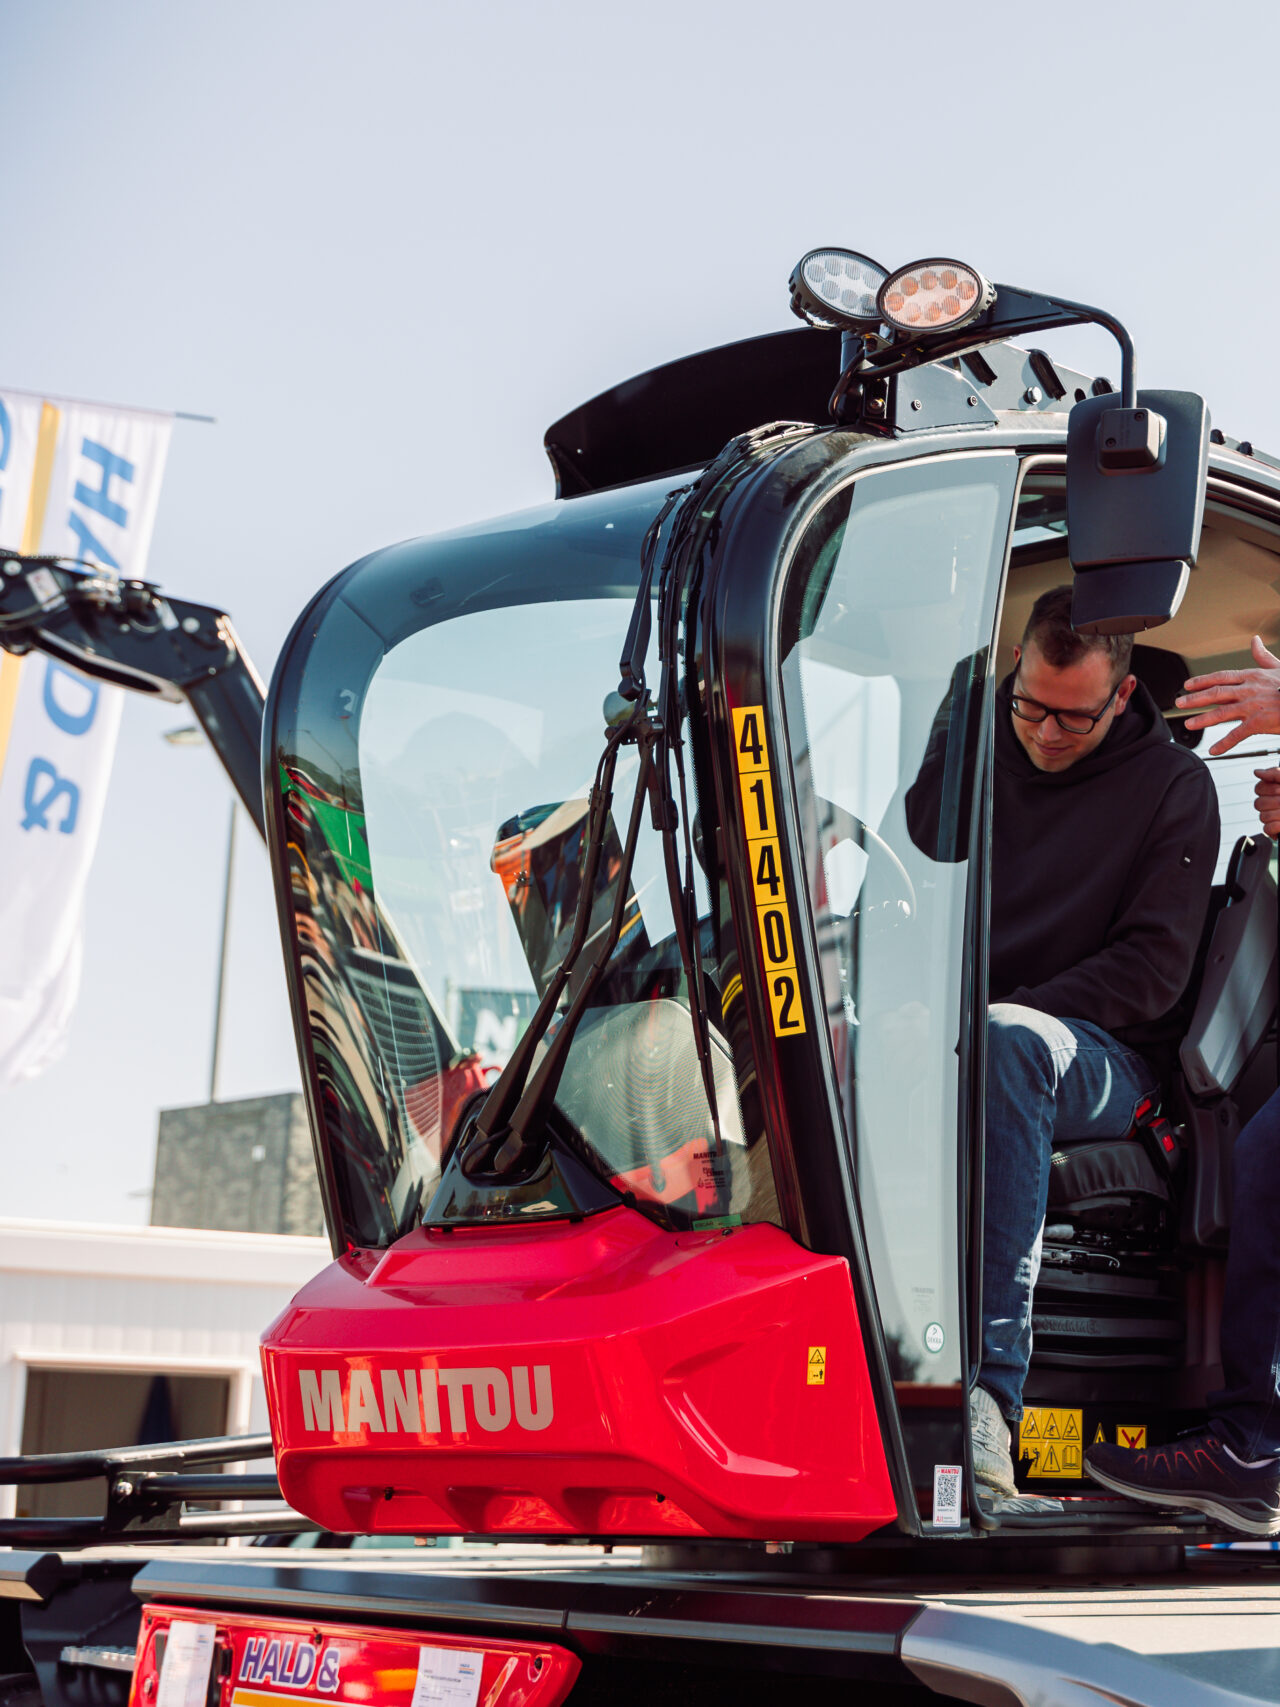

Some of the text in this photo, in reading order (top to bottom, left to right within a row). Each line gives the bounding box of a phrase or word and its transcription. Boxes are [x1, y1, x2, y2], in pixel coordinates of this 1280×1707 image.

[20, 756, 81, 834] &
[739, 712, 799, 1030] 41402
[299, 1364, 554, 1433] MANITOU
[239, 1637, 341, 1694] HALD &
